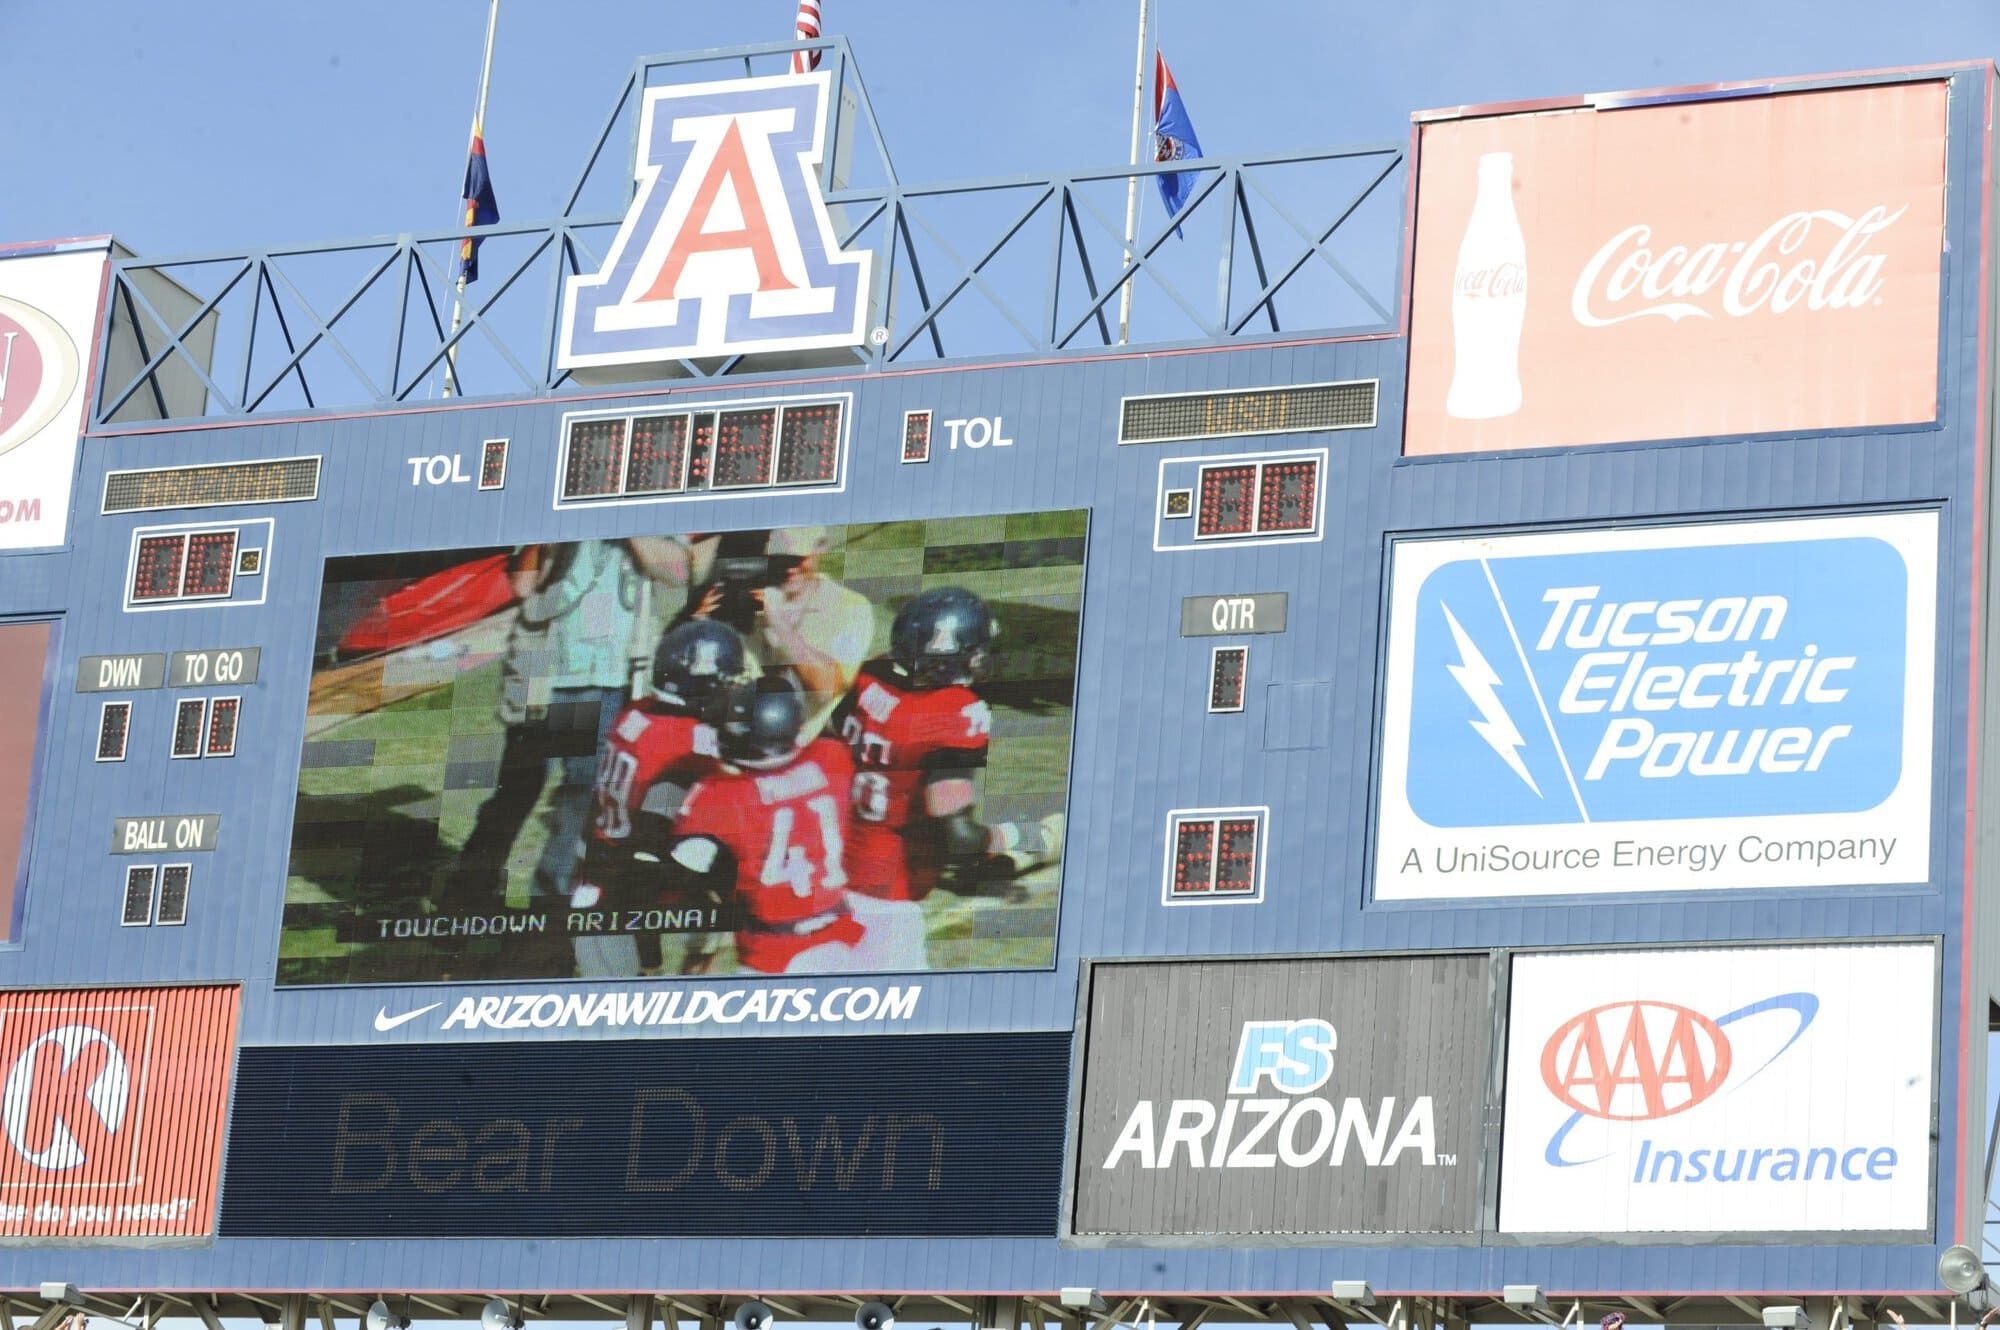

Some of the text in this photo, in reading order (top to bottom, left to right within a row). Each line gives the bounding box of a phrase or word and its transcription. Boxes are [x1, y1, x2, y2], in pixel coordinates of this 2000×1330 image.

[1572, 203, 1908, 327] Coca-Cola
[944, 416, 1013, 450] TOL
[1206, 392, 1290, 435] WSU
[407, 453, 471, 486] TOL
[1212, 598, 1255, 632] QTR
[1536, 585, 1788, 651] Tucson
[99, 656, 142, 688] DWN
[185, 651, 243, 683] TO GO
[1558, 644, 1857, 714] Electric
[1584, 717, 1853, 781] Power
[124, 818, 204, 850] BALL ON
[1400, 834, 1897, 873] A UniSource Energy Company
[377, 908, 718, 937] TOUCHDOWN ARIZONA!
[440, 985, 921, 1031] ARIZONAWILDCATS.COM
[1228, 1018, 1338, 1095] FS
[1560, 1003, 1708, 1118] AAA
[331, 1087, 945, 1193] Bear Down
[1102, 1096, 1437, 1169] ARIZONA
[1632, 1139, 1899, 1184] Insurance
